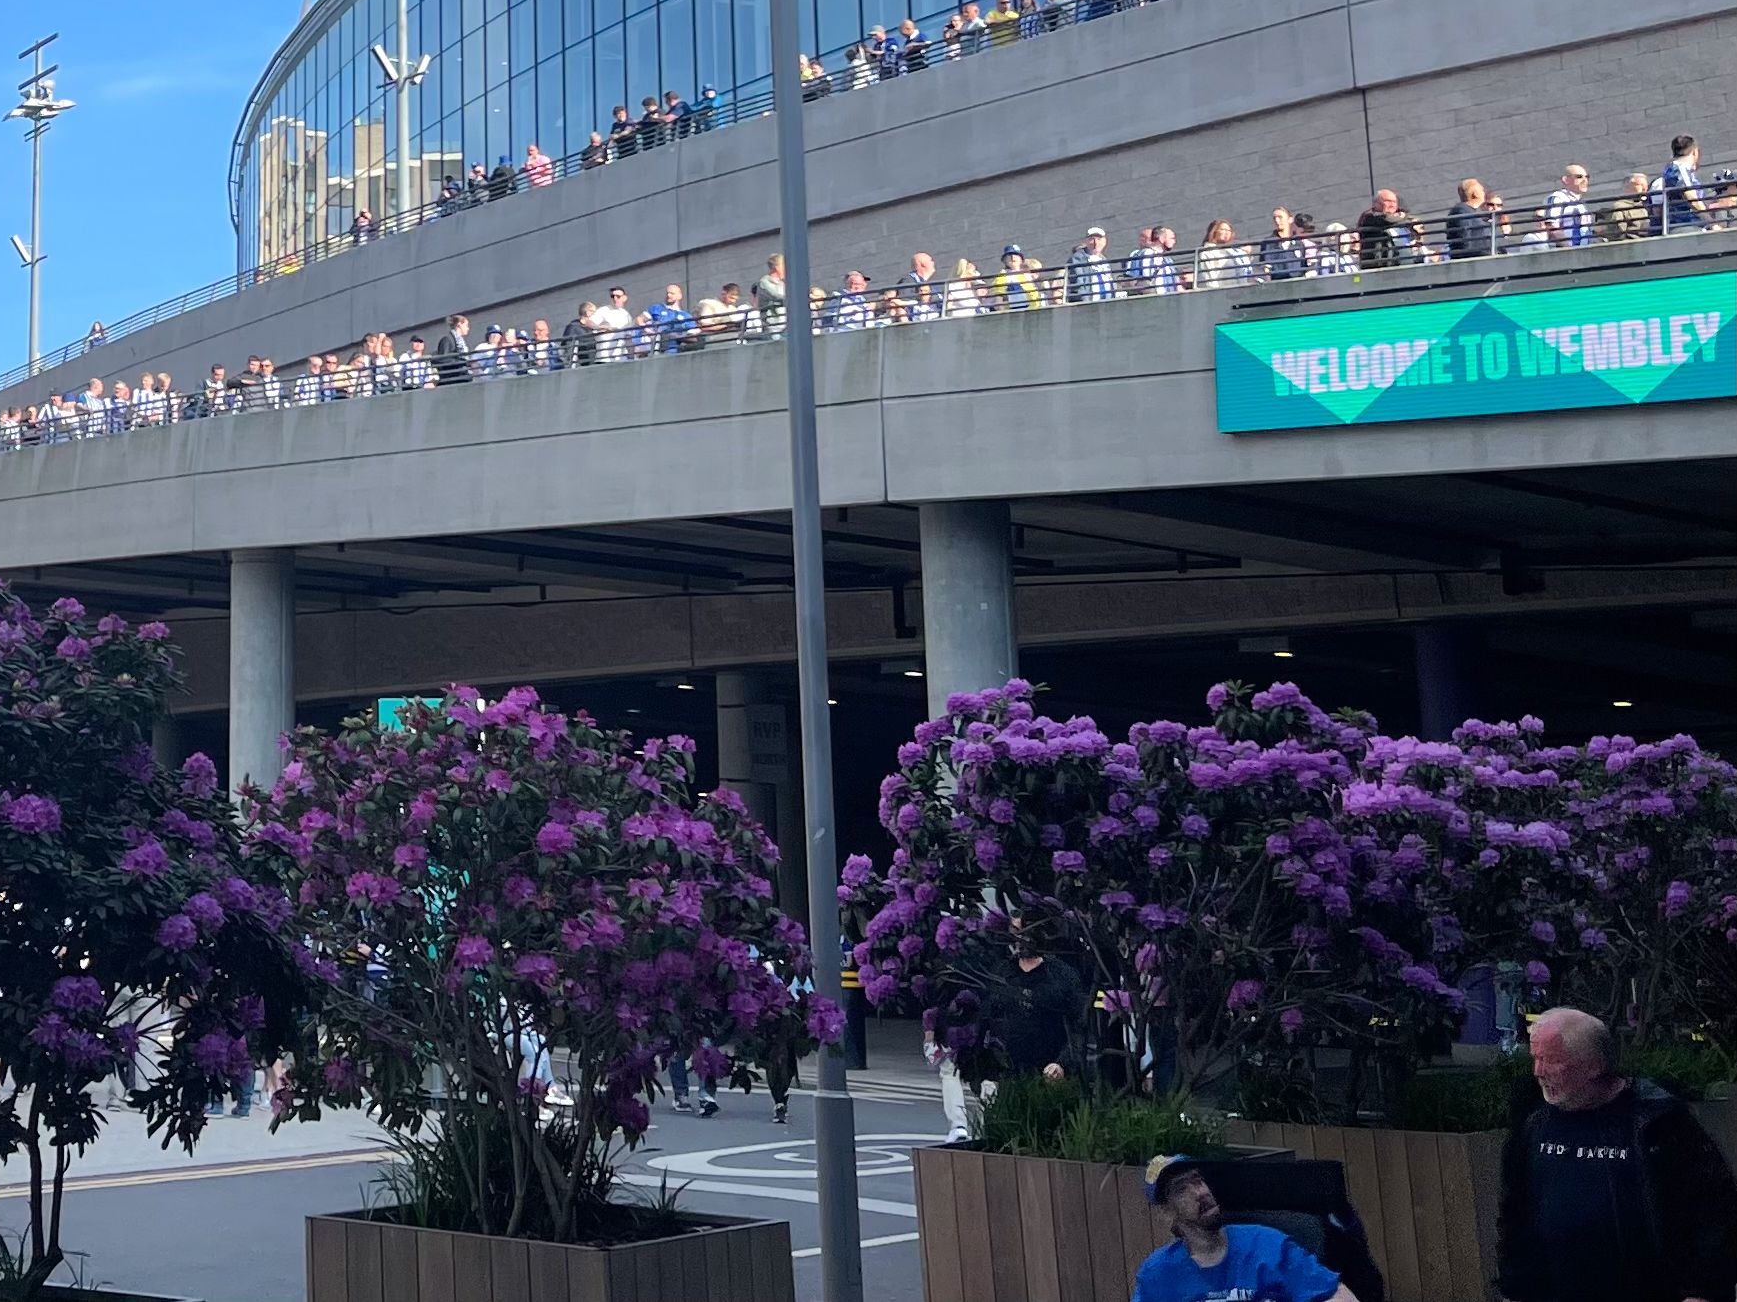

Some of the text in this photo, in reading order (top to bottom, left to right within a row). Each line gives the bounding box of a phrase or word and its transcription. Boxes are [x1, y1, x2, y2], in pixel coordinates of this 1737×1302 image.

[1271, 311, 1721, 396] WELCOME TO WEMBLEY
[1576, 1146, 1629, 1160] BAKER
